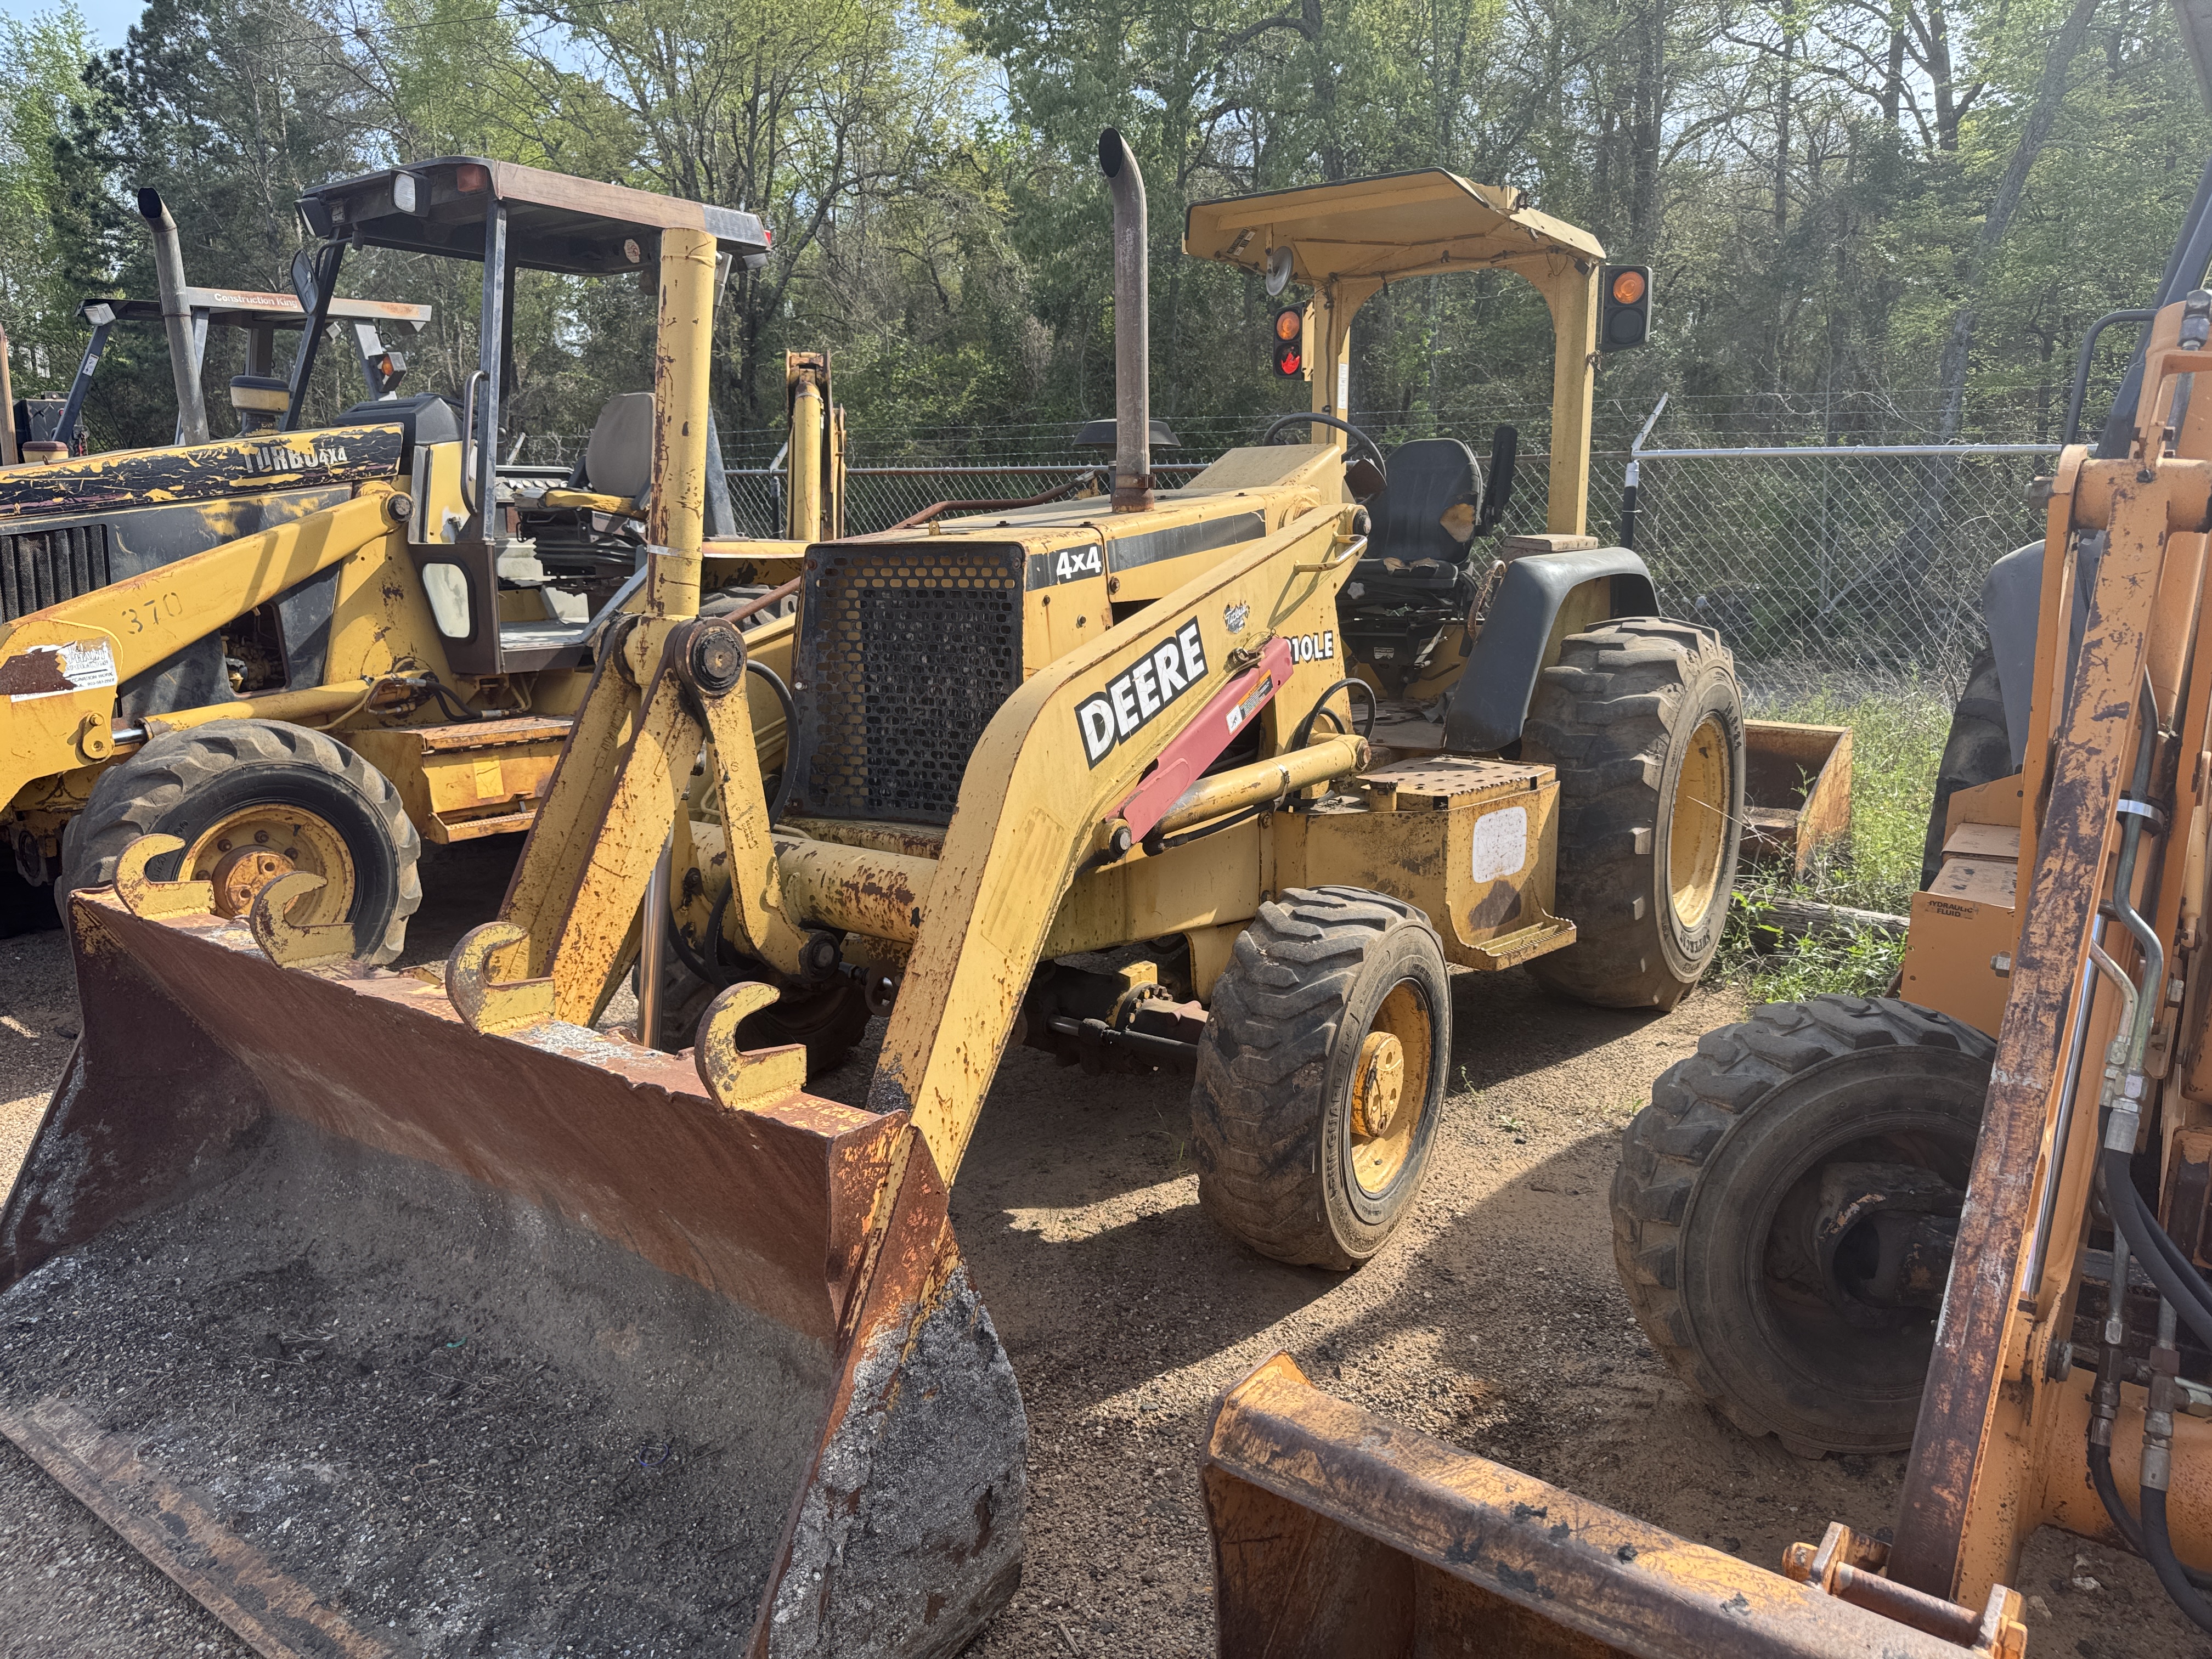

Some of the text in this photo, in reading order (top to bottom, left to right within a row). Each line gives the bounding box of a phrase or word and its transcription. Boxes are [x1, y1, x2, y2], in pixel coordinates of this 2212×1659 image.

[214, 293, 298, 308] Construction King
[1056, 546, 1102, 579] 4x4
[122, 592, 183, 635] 370
[1080, 623, 1205, 761] DEERE
[1927, 900, 1974, 913] HYDRAULIC
[1937, 908, 1961, 917] FLUID
